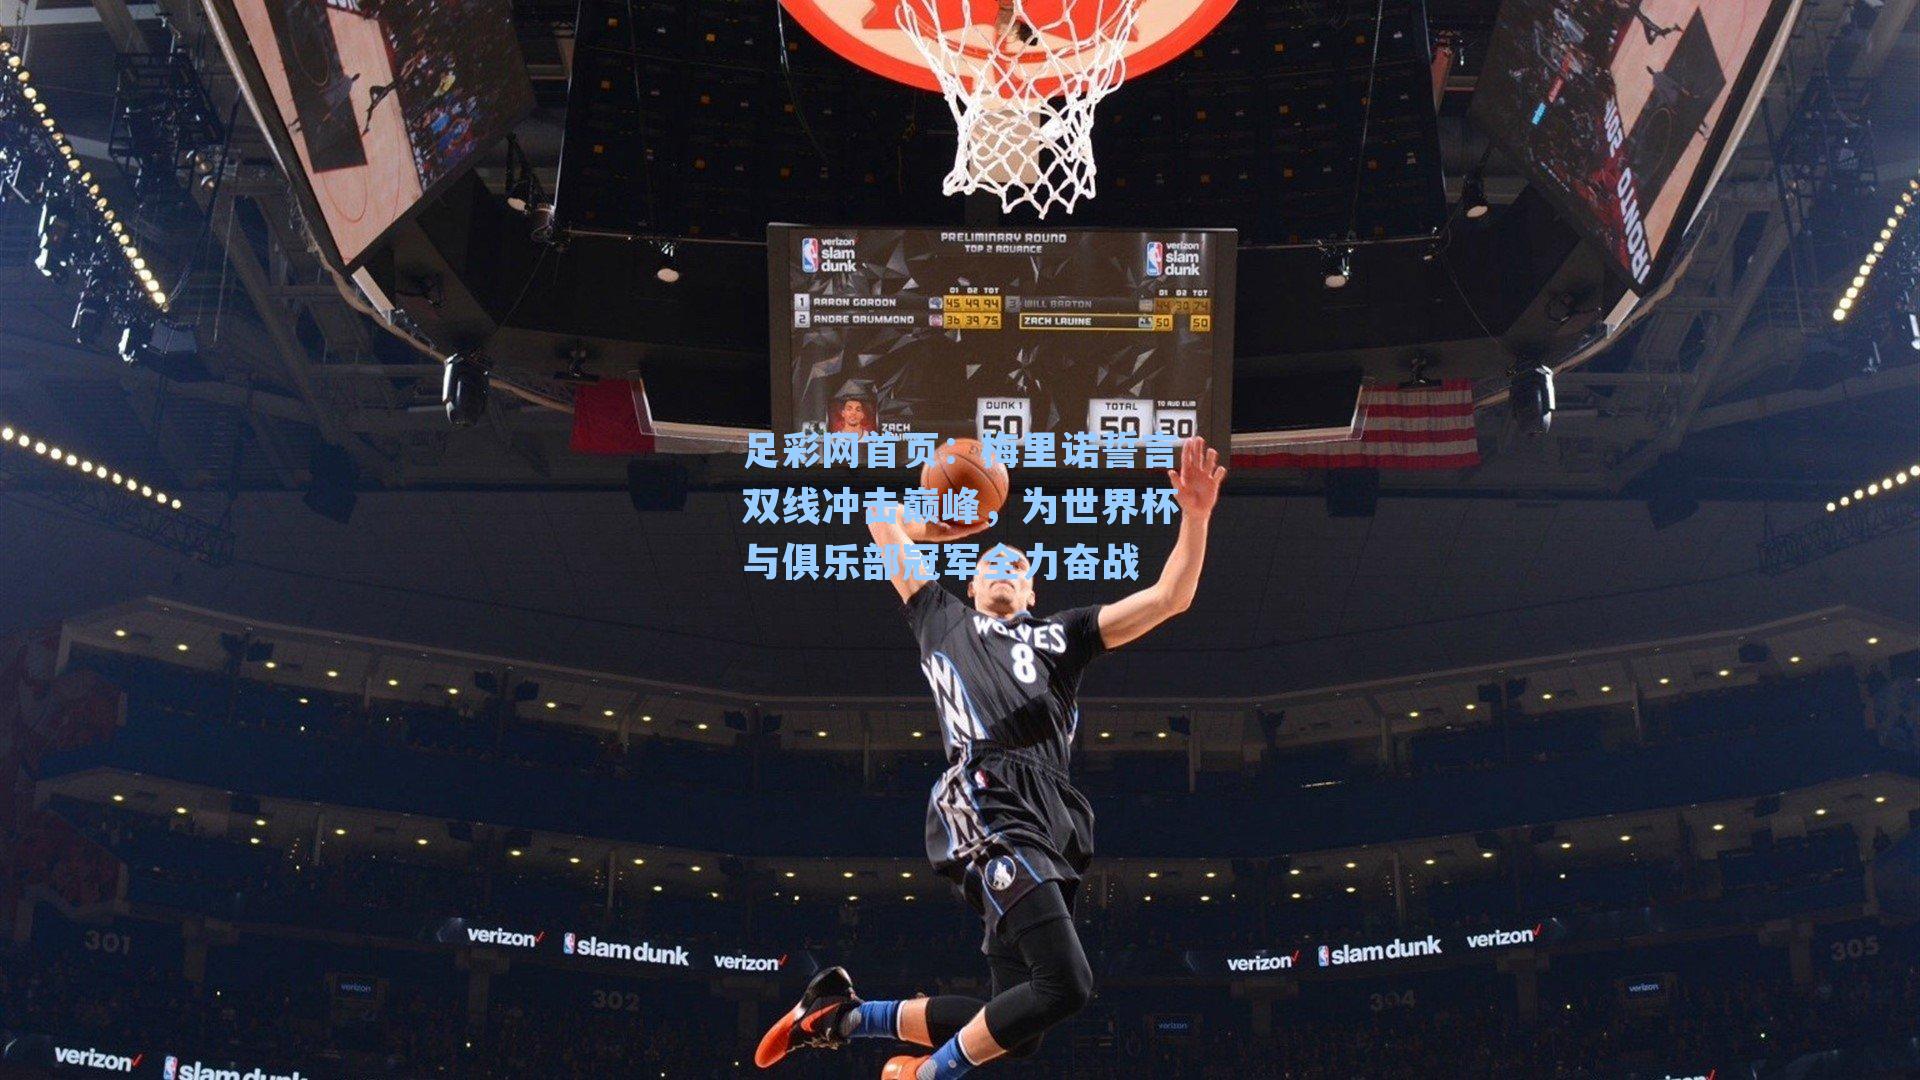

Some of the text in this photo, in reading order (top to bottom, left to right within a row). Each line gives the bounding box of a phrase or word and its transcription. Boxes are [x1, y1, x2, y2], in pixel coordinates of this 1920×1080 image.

[821, 237, 855, 246] verizon
[941, 232, 1067, 243] PRELIMINARY ROUND
[965, 244, 1043, 253] TOP 2 ADVANCE
[1166, 241, 1200, 250] verizon
[821, 246, 856, 259] slam
[1165, 251, 1200, 263] slam
[821, 260, 857, 272] dunk
[1164, 264, 1200, 276] dunk
[798, 296, 999, 309] 1 AARON GORDON 45 49 94
[1024, 300, 1048, 308] WILL
[1050, 300, 1092, 309] BARTON
[797, 314, 999, 325] 2 ANDRE DRUMMOND 36 39 75
[1024, 316, 1208, 328] ZACH LAVINE 50 50
[985, 401, 1014, 410] DUNK
[1105, 402, 1139, 411] TOTAL
[881, 423, 911, 432] ZACH
[982, 415, 1023, 440] 50
[1100, 416, 1141, 440] 50
[1160, 418, 1194, 438] 30
[1011, 643, 1037, 683] 8
[84, 930, 131, 954] 301
[467, 926, 536, 948] verizon
[1466, 927, 1533, 948] verizon
[576, 936, 690, 967] slam dunk
[1330, 934, 1442, 966] slam dunk
[1830, 936, 1879, 962] 305
[714, 953, 779, 972] verizon
[1227, 953, 1292, 972] verizon
[340, 982, 372, 993] verizon
[1628, 982, 1659, 992] verizon
[54, 1046, 132, 1072] verizon
